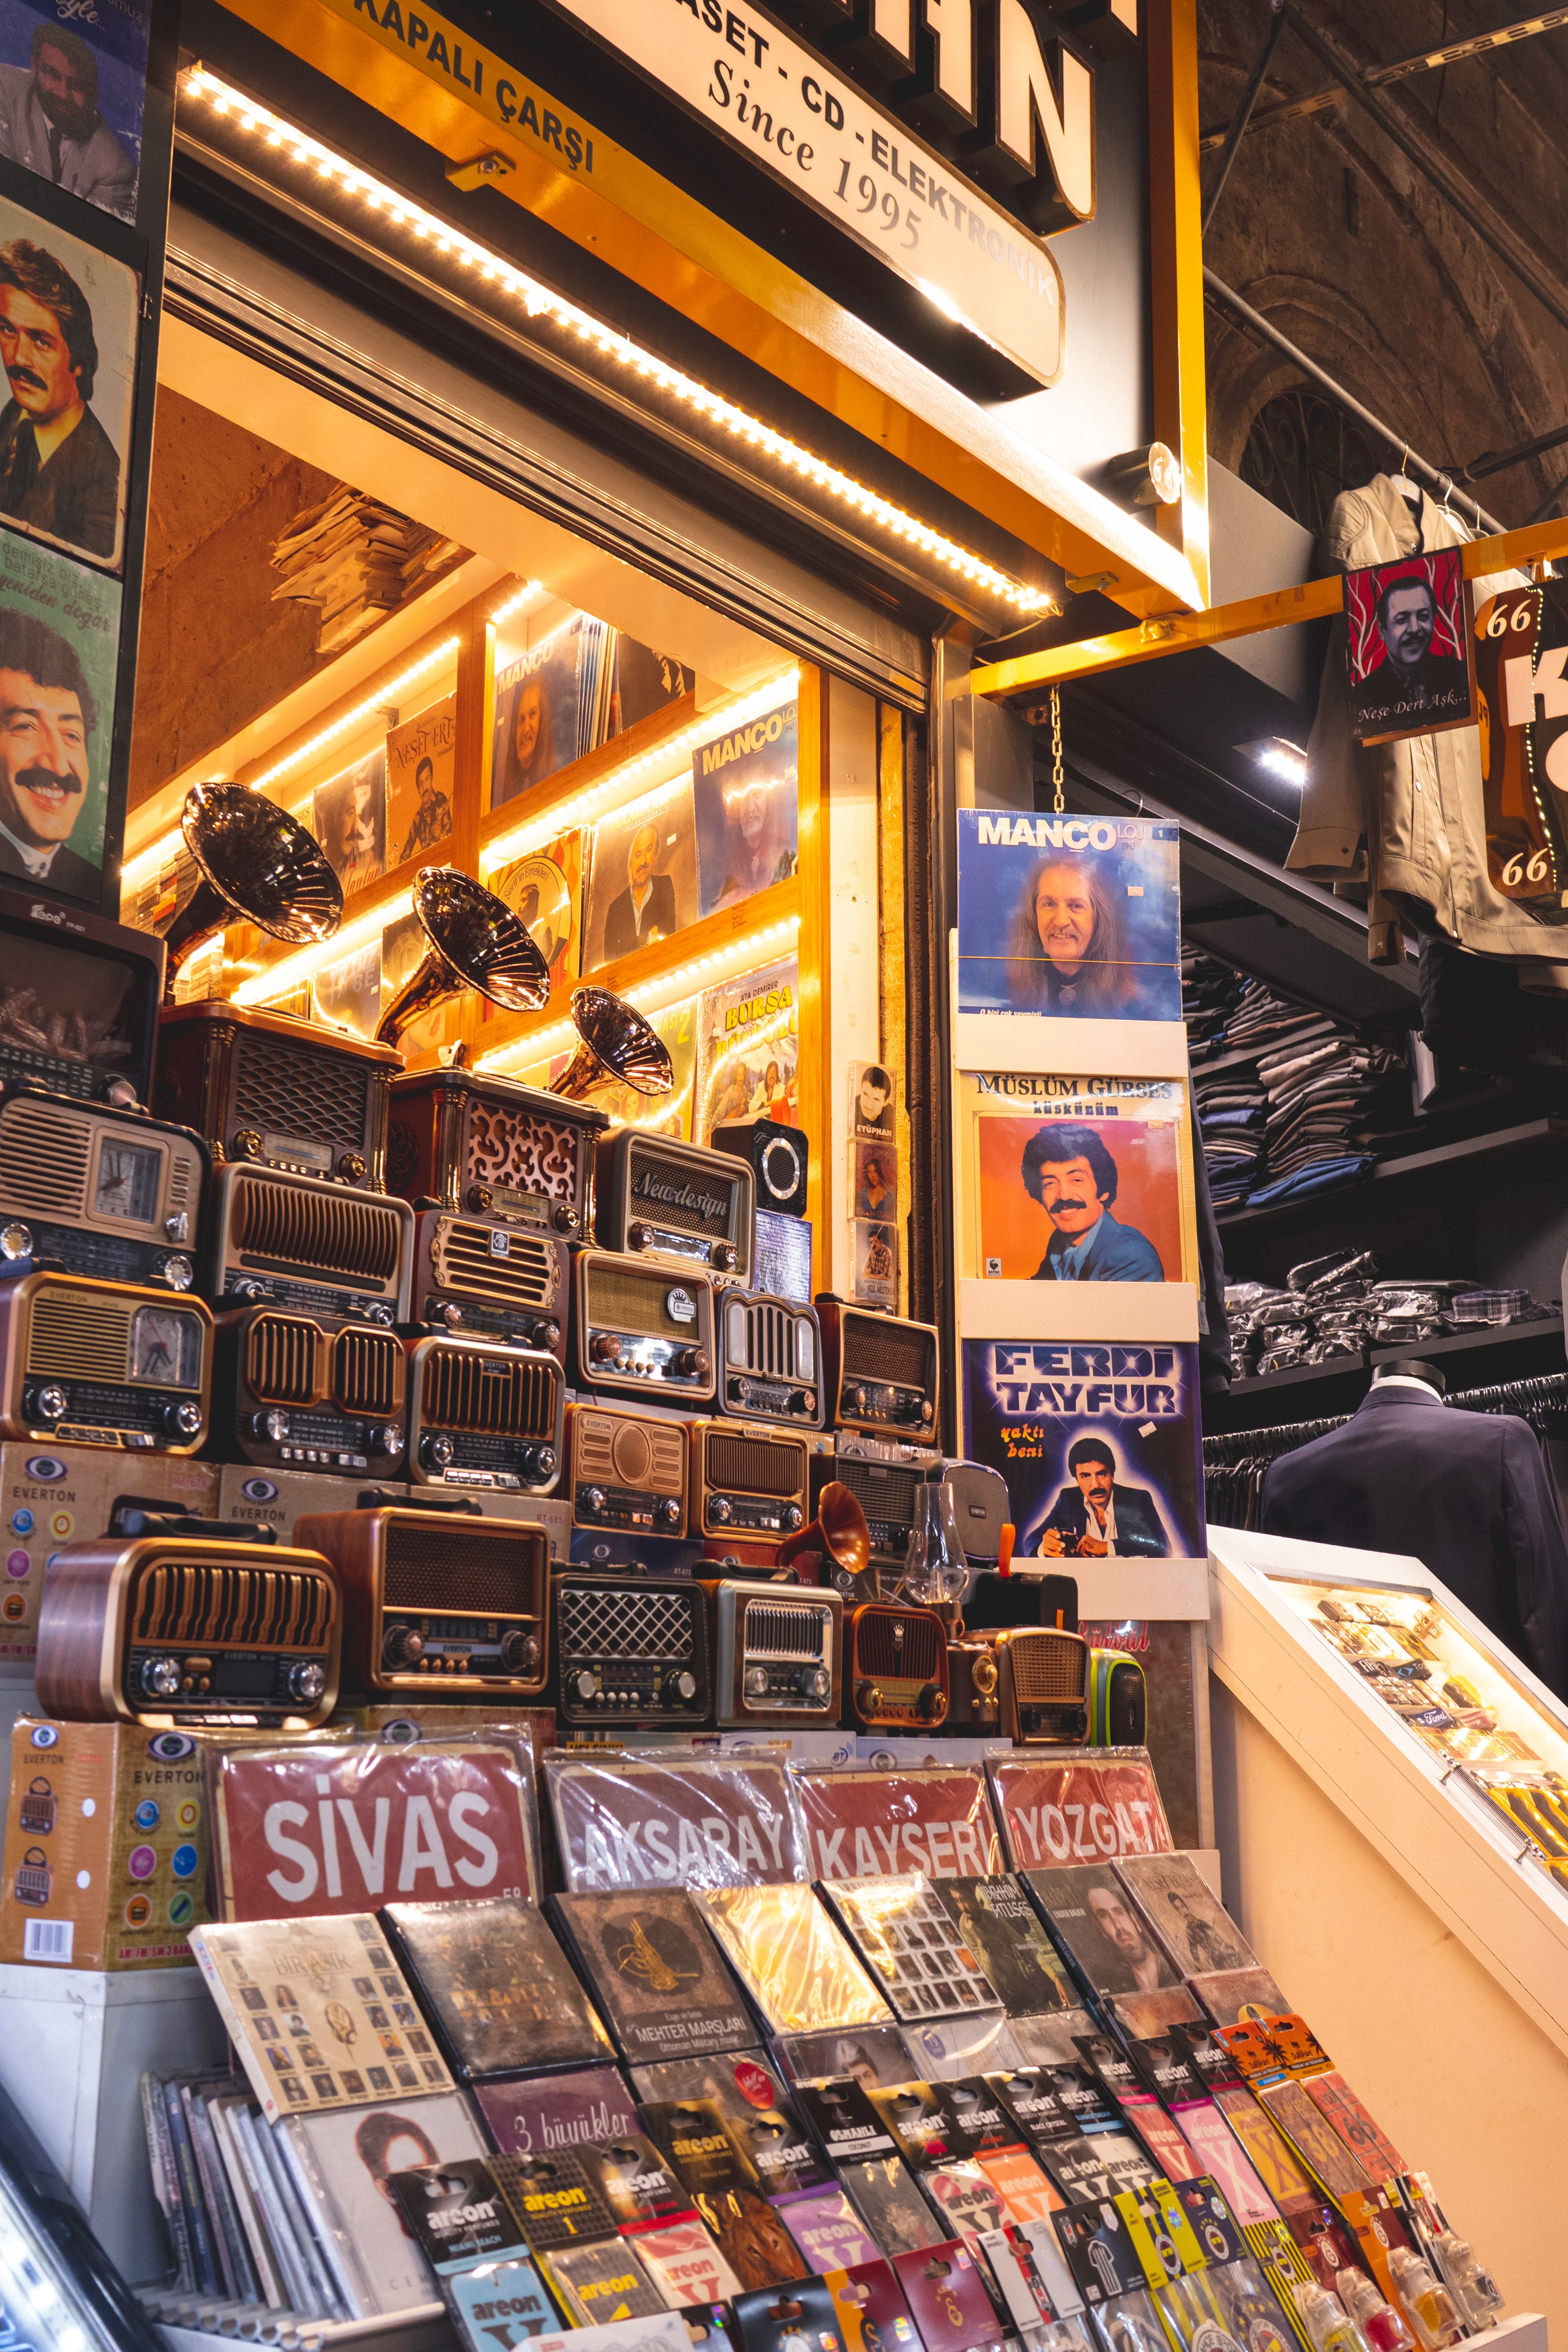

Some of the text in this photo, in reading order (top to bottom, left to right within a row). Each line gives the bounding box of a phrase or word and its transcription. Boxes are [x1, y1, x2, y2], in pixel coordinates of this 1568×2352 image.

[352, 0, 594, 175] KAPALI ÇARŞI
[801, 76, 845, 133] CD
[708, 59, 814, 172] Since
[833, 158, 923, 250] 1995
[1487, 599, 1531, 638] 66
[1393, 699, 1426, 714] Dert
[702, 714, 783, 776] MANÇO
[978, 816, 1117, 852] MANÇO
[1502, 848, 1548, 887] 66
[740, 981, 778, 1002] ATA DEMİRER
[725, 985, 793, 1033] BURSA
[977, 1075, 1173, 1100] MÜSLÜM GÜRSES
[1033, 1101, 1119, 1116] küskünüm
[857, 1124, 892, 1137] EYÜPHAN
[50, 1291, 88, 1304] EVERTON
[995, 1345, 1174, 1379] FERDİ
[996, 1382, 1176, 1414] TAYFUR
[587, 1420, 611, 1430] EVERTON
[746, 1429, 771, 1439] EVERTON
[1007, 1443, 1043, 1458] beni
[13, 1487, 76, 1503] EVERTON
[231, 1507, 286, 1522] EVERTON
[1424, 1710, 1447, 1724] Ford
[24, 1753, 64, 1766] EVERTON
[134, 1770, 205, 1785] EVERTON
[264, 1774, 498, 1903] SİVAS
[1014, 1801, 1154, 1861] YOZGAT
[584, 1812, 783, 1886] AKSARAY
[816, 1809, 988, 1879] KAYSERİ
[1055, 1909, 1069, 1919] ENDER
[635, 2017, 747, 2043] MEHTER MARŞLARI
[660, 2041, 690, 2052] Ottoman
[1193, 2048, 1228, 2063] areon
[1100, 2062, 1131, 2075] areon
[1153, 2065, 1190, 2081] areon
[1012, 2095, 1056, 2113] areon
[1059, 2088, 1100, 2105] areon
[514, 2102, 629, 2152] 3 büyükler
[897, 2113, 945, 2136] areon
[956, 2108, 1000, 2128] areon
[1030, 2118, 1067, 2131] BLACK CRYSTAL
[829, 2125, 877, 2141] OSMANLI
[1147, 2129, 1179, 2142] areon
[672, 2133, 729, 2156] areon
[755, 2144, 810, 2168] areon
[606, 2171, 667, 2195] areon
[999, 2174, 1044, 2194] areon
[522, 2187, 587, 2211] areon
[947, 2186, 994, 2210] areon
[426, 2200, 496, 2229] areon
[562, 2216, 578, 2235] 1
[476, 2234, 503, 2247] BEACH
[801, 2221, 858, 2246] areon
[577, 2273, 639, 2301] areon
[471, 2294, 542, 2320] areon
